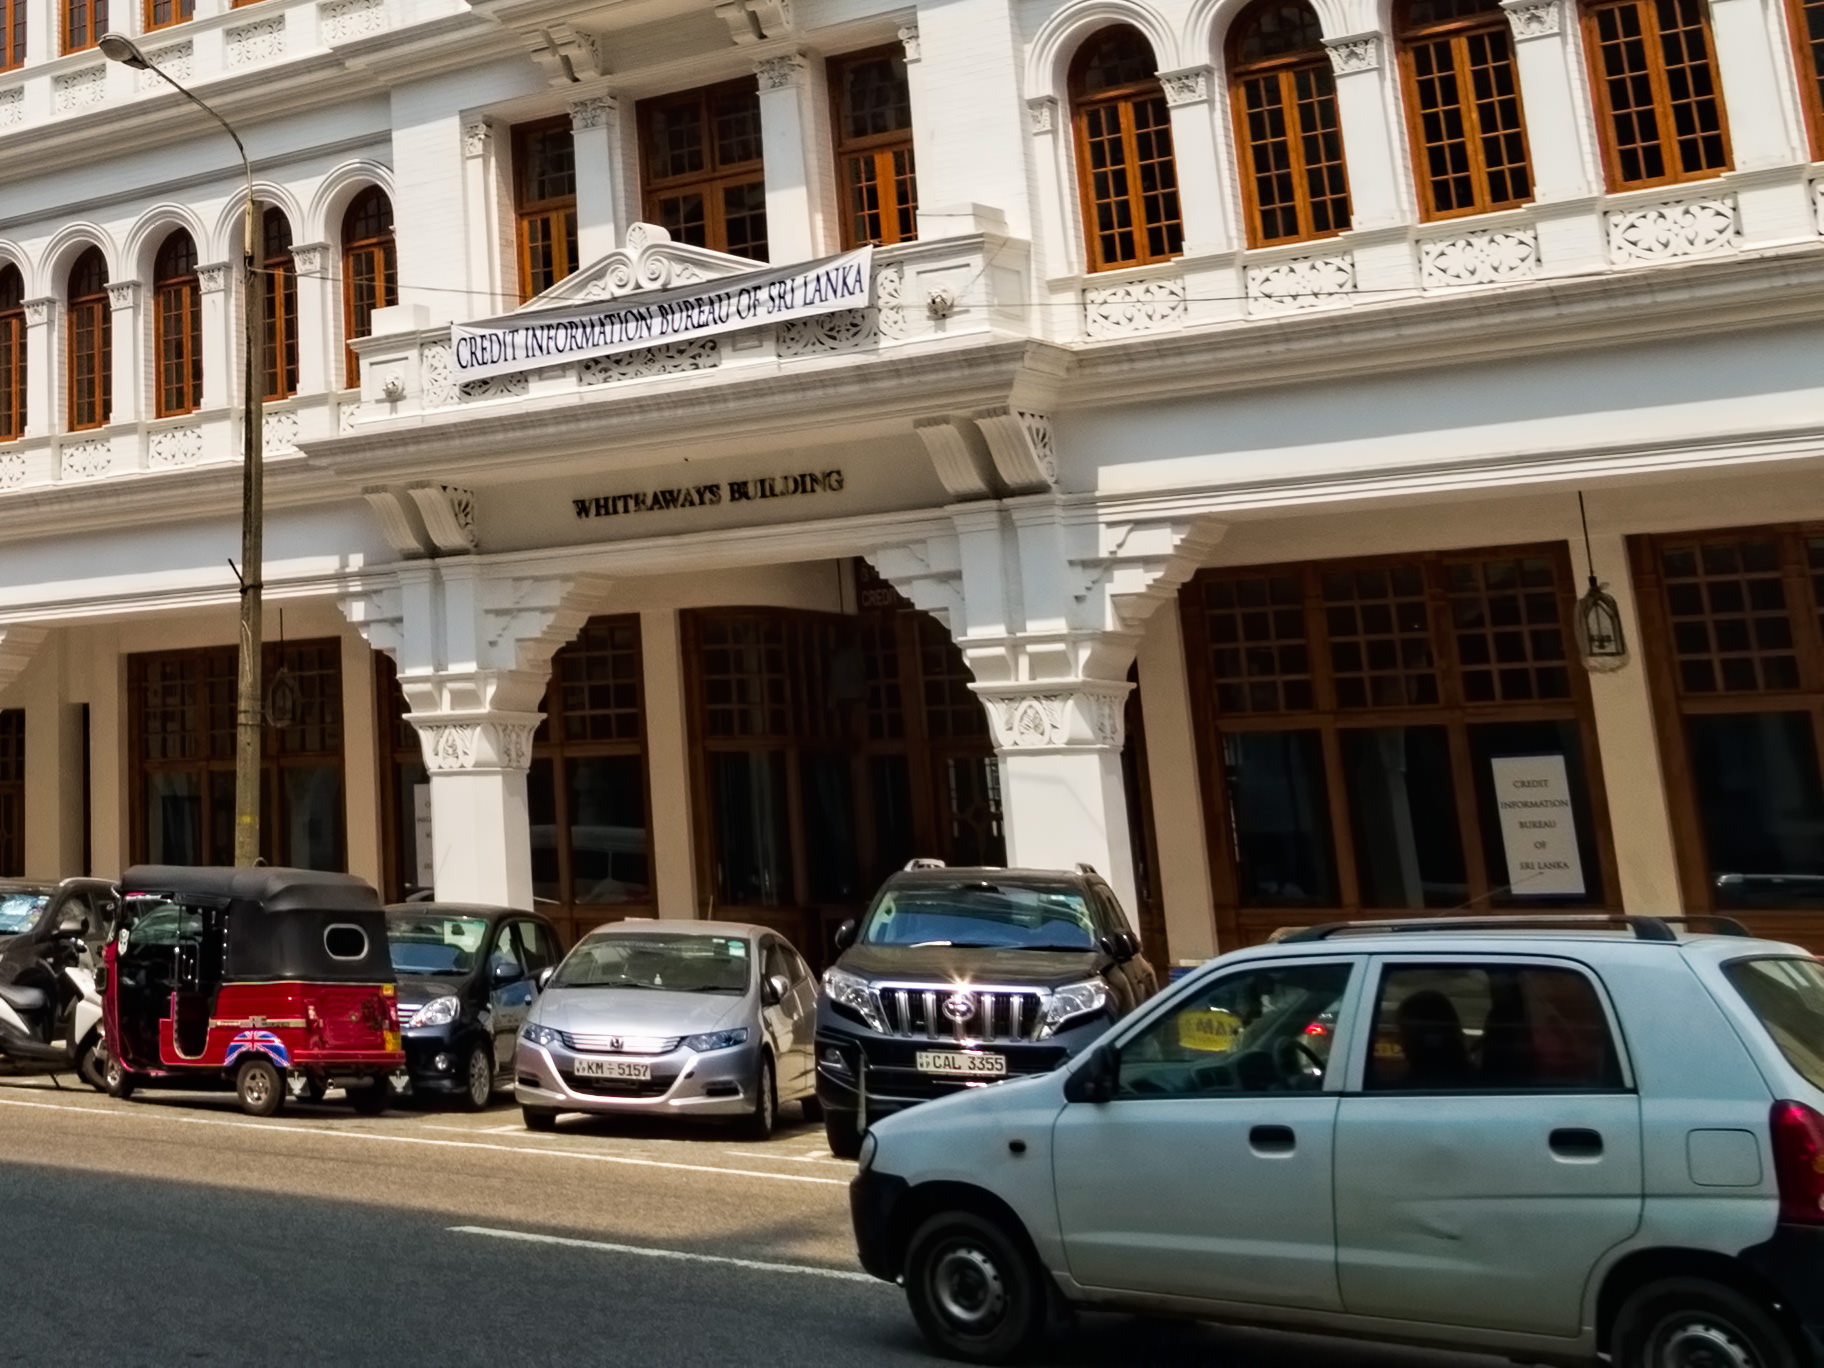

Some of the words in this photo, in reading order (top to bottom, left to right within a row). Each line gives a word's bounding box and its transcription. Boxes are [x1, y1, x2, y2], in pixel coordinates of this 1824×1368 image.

[456, 329, 518, 369] CREDIT
[525, 306, 652, 359] INFORMATION
[658, 291, 730, 336] BUREAU
[736, 285, 762, 320] OF
[767, 278, 795, 314] SRI
[802, 262, 864, 308] LANKA
[727, 469, 845, 502] BUILDING
[1512, 779, 1549, 788] CREDIT
[1500, 799, 1569, 809] INFORMATION
[1518, 820, 1556, 829] BUREAU
[1537, 860, 1570, 870] LANKA
[586, 1061, 604, 1075] KM
[617, 1063, 649, 1077] 5157
[932, 1054, 962, 1070] CAL
[967, 1056, 1005, 1072] 3355
